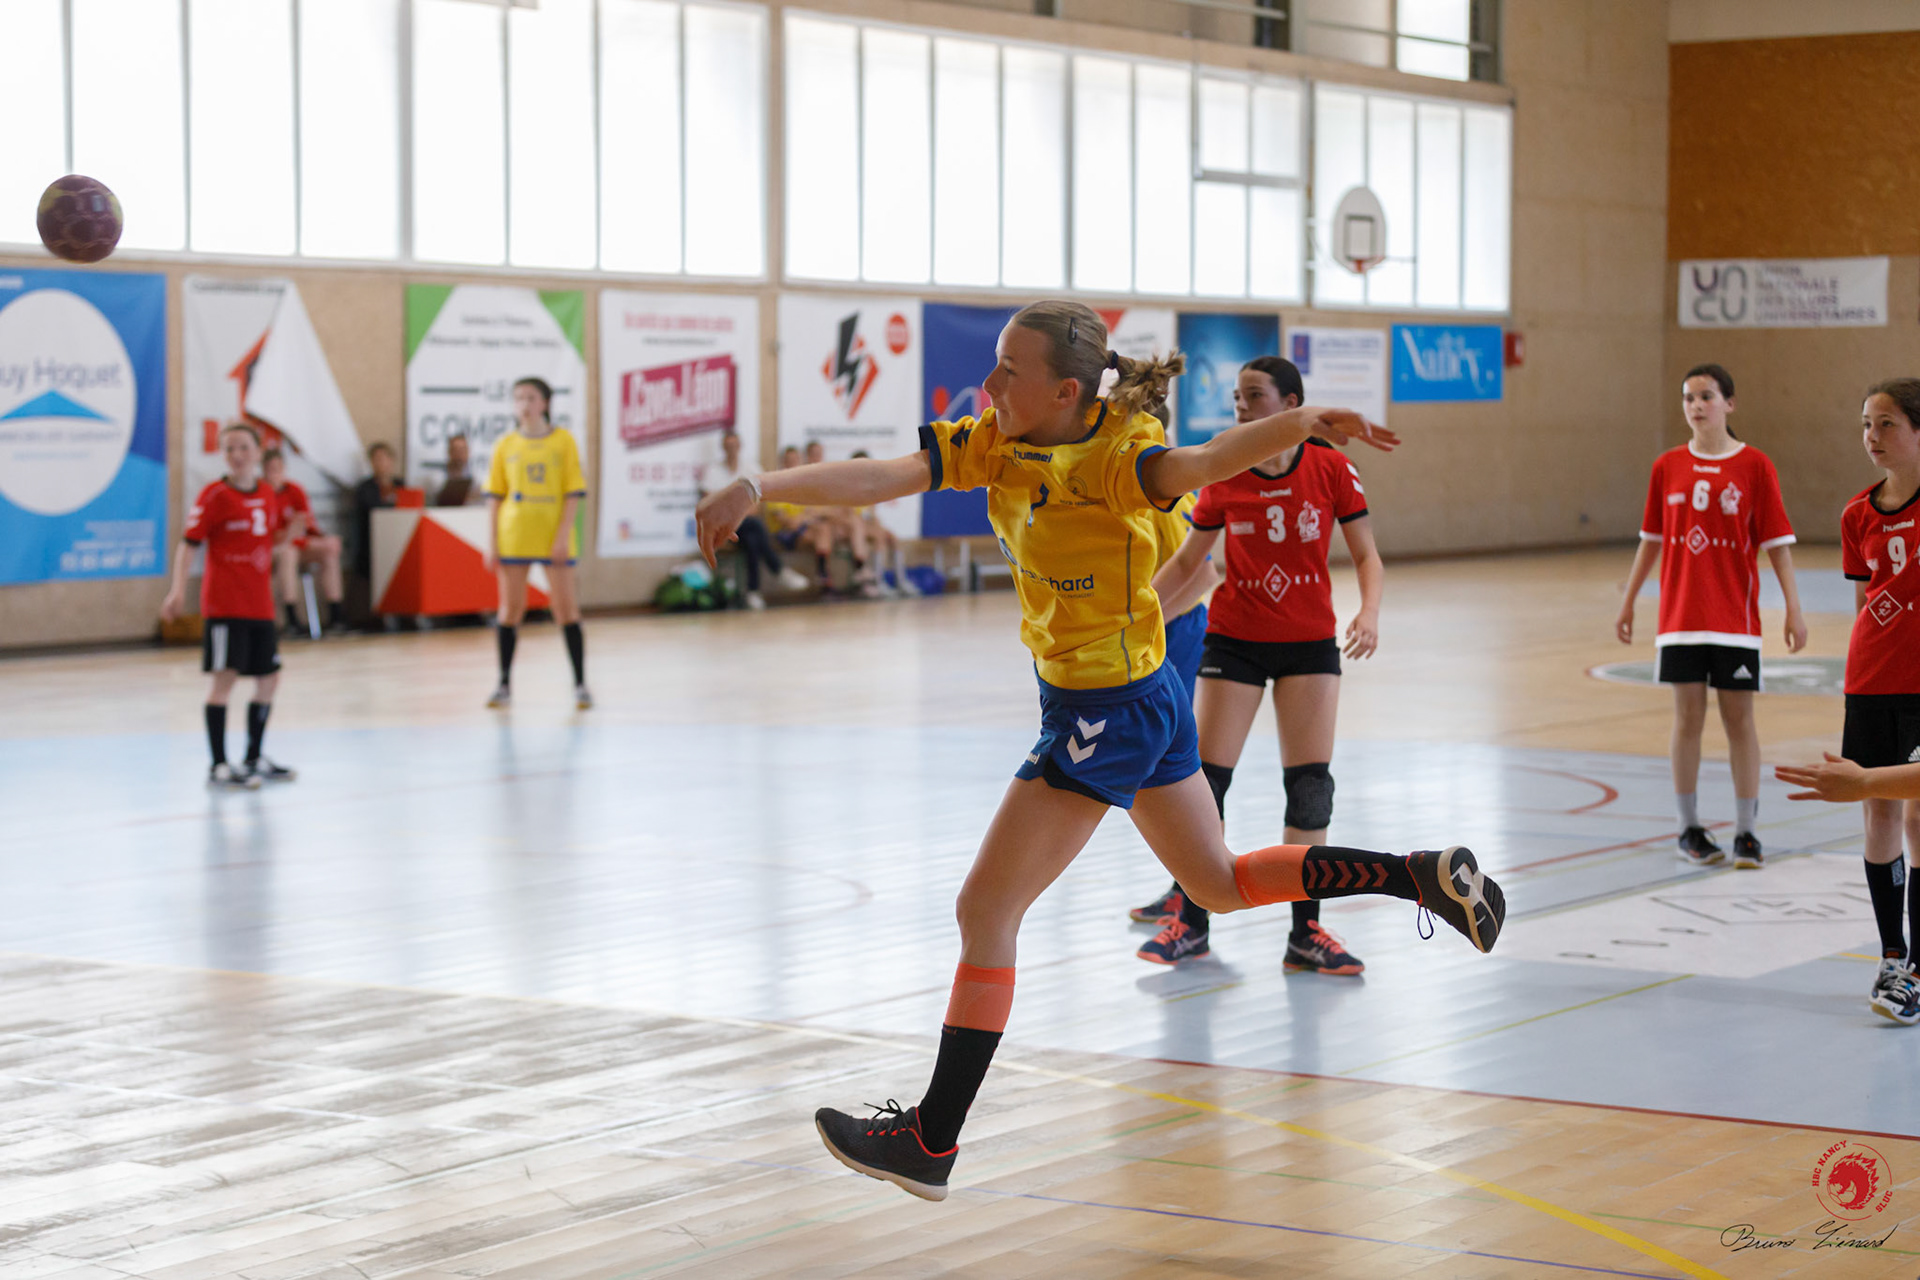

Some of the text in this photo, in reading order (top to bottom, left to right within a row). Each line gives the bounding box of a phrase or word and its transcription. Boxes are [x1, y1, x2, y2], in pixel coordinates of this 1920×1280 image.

[1013, 446, 1053, 463] hummel
[1692, 480, 1711, 511] 6
[1266, 505, 1287, 543] 3
[1887, 535, 1908, 576] 9
